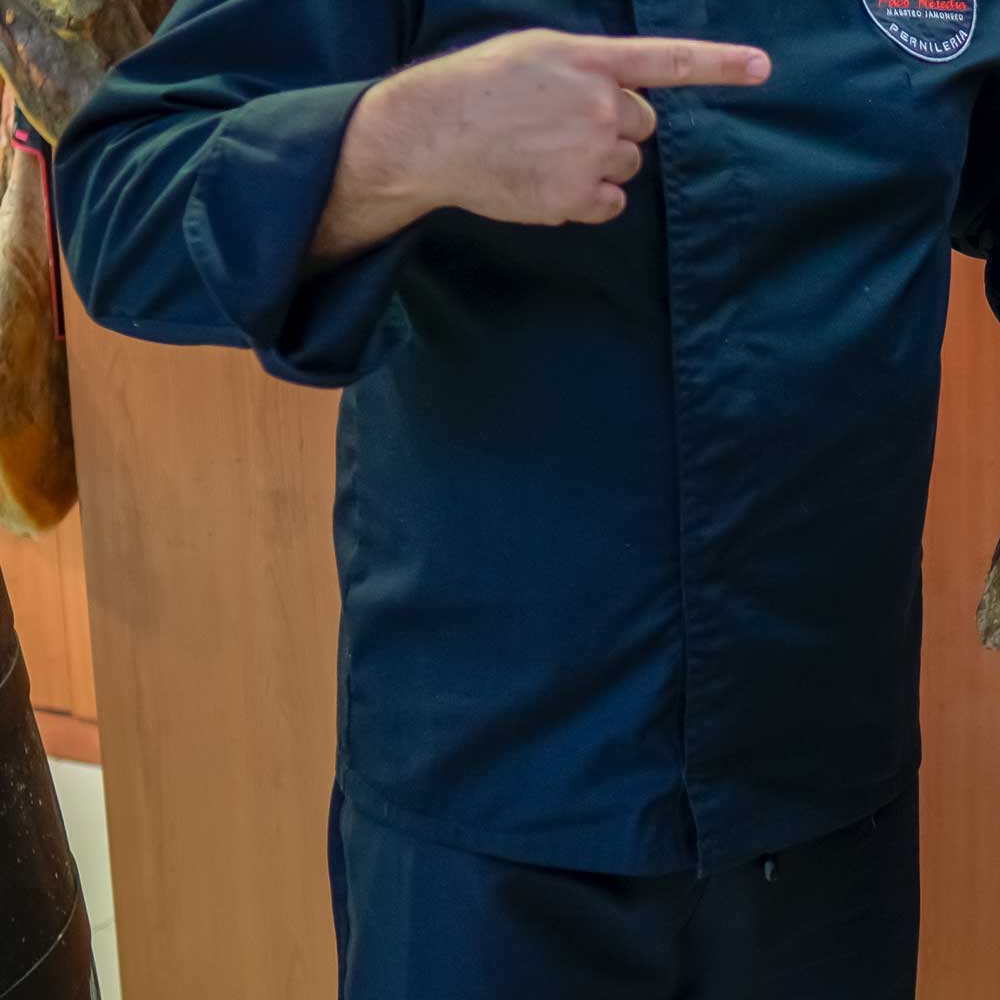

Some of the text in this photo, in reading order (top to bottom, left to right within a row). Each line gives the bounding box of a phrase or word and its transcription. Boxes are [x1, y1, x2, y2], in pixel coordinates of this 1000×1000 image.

[886, 7, 965, 22] MAESTRO JAMONERO
[888, 22, 968, 54] PERNILERIA
